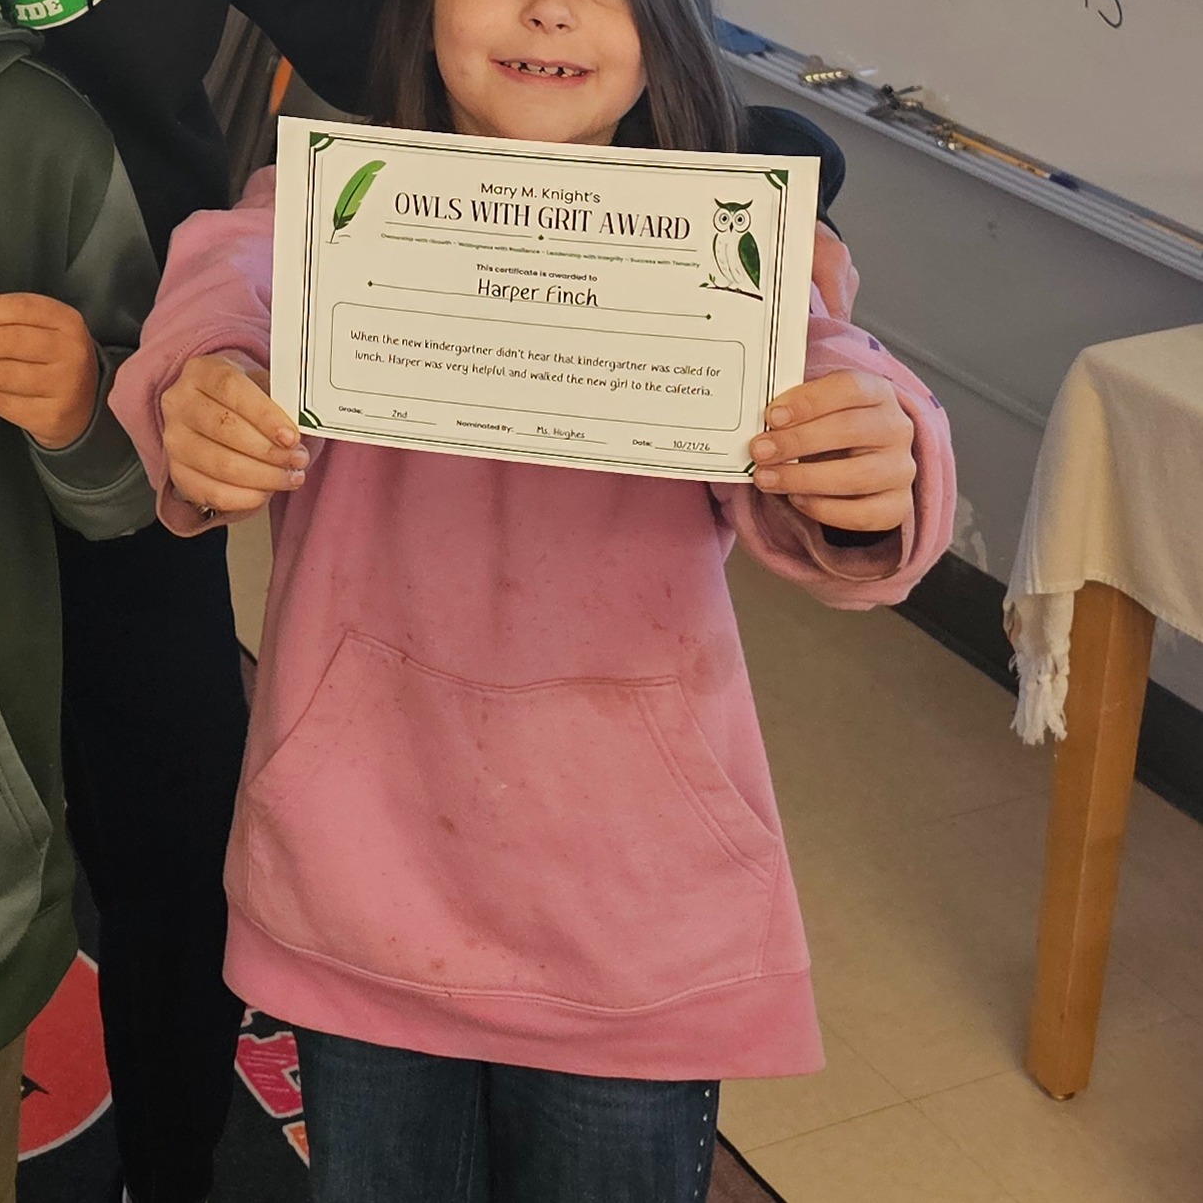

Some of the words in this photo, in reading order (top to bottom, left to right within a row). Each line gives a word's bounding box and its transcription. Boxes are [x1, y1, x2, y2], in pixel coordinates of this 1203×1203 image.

[480, 183, 517, 199] Mary
[521, 186, 538, 198] M.
[542, 188, 600, 204] Knight's
[395, 192, 463, 221] OWLS
[470, 199, 531, 227] WITH
[538, 206, 592, 232] GRIT
[599, 212, 691, 239] AWARD
[476, 263, 494, 272] This
[494, 266, 539, 276] certificate
[548, 272, 587, 281] awarded
[478, 278, 540, 302] Harper
[546, 285, 598, 307] Finch
[350, 330, 379, 343] When
[382, 334, 400, 346] the
[402, 338, 421, 348] new
[425, 339, 493, 356] kindergartner
[496, 348, 525, 359] didn't
[527, 350, 551, 361] hear
[553, 352, 575, 364] that
[577, 356, 647, 372] kindergartner
[651, 364, 670, 373] was
[673, 365, 703, 376] called
[706, 366, 721, 377] for
[355, 350, 385, 363] lunch.
[388, 353, 423, 368] Harper
[424, 361, 443, 370] was
[446, 363, 468, 375] very
[472, 363, 506, 377] helpful
[509, 368, 527, 379] and
[530, 371, 563, 382] walked
[567, 374, 583, 384] the
[586, 377, 607, 386] new
[610, 379, 628, 392] girl
[631, 380, 642, 390] to
[645, 381, 661, 392] the
[665, 383, 713, 397] cafeteria.
[392, 409, 407, 419] 2nd
[456, 420, 500, 431] Nominated
[553, 428, 585, 439] Hughes
